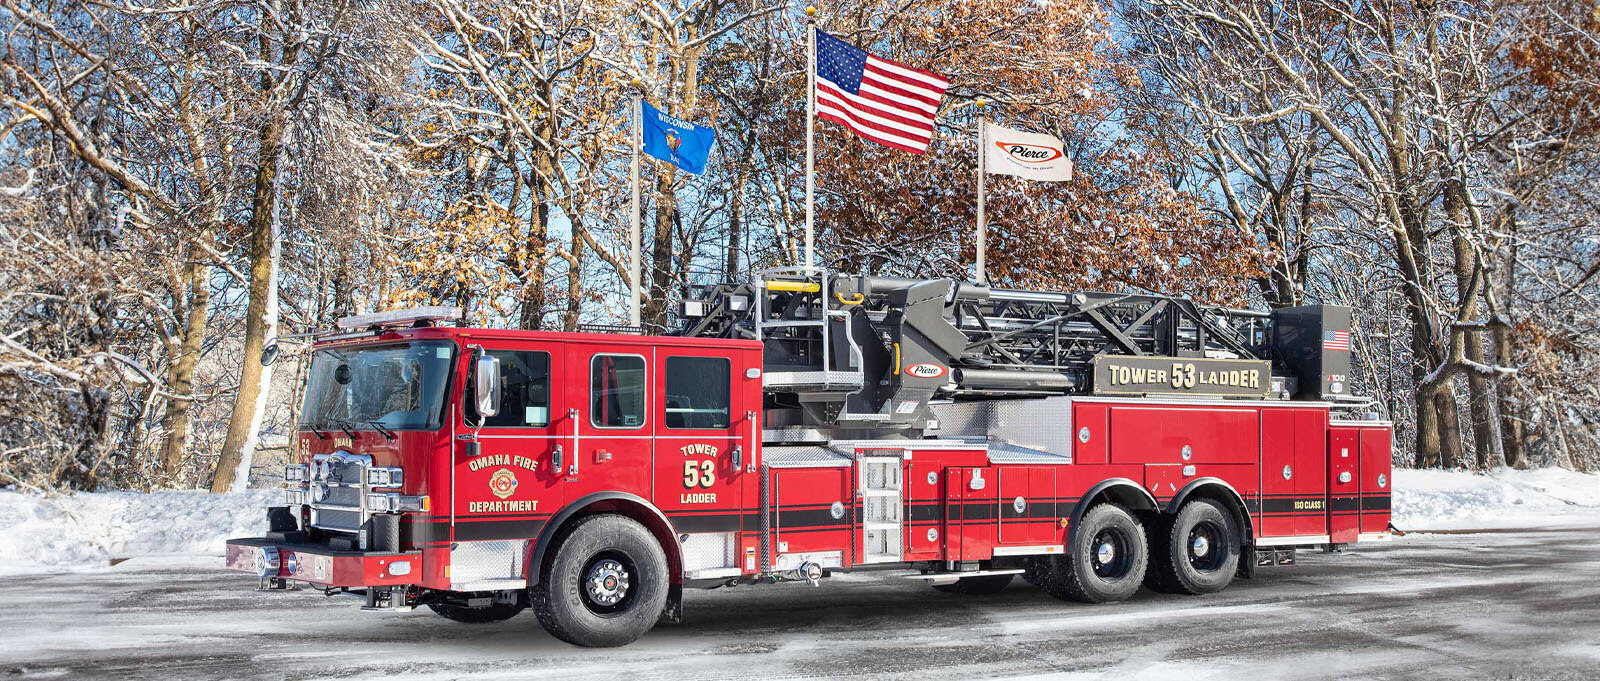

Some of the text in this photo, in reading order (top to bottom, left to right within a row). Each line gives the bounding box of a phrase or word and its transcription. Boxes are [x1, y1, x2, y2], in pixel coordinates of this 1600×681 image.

[658, 112, 696, 131] WISCONSIN
[1010, 145, 1049, 159] Pierce
[914, 365, 938, 375] Pierce
[1109, 363, 1260, 390] TOWER 53 LADDER
[301, 438, 310, 456] 53
[333, 437, 353, 449] OMAHA
[680, 443, 718, 458] TOWER
[468, 454, 539, 472] OMAHA FIRE
[682, 459, 716, 490] 53
[680, 493, 717, 504] LADDER
[1304, 500, 1321, 509] CLASS
[469, 500, 539, 513] DEPARTMENT
